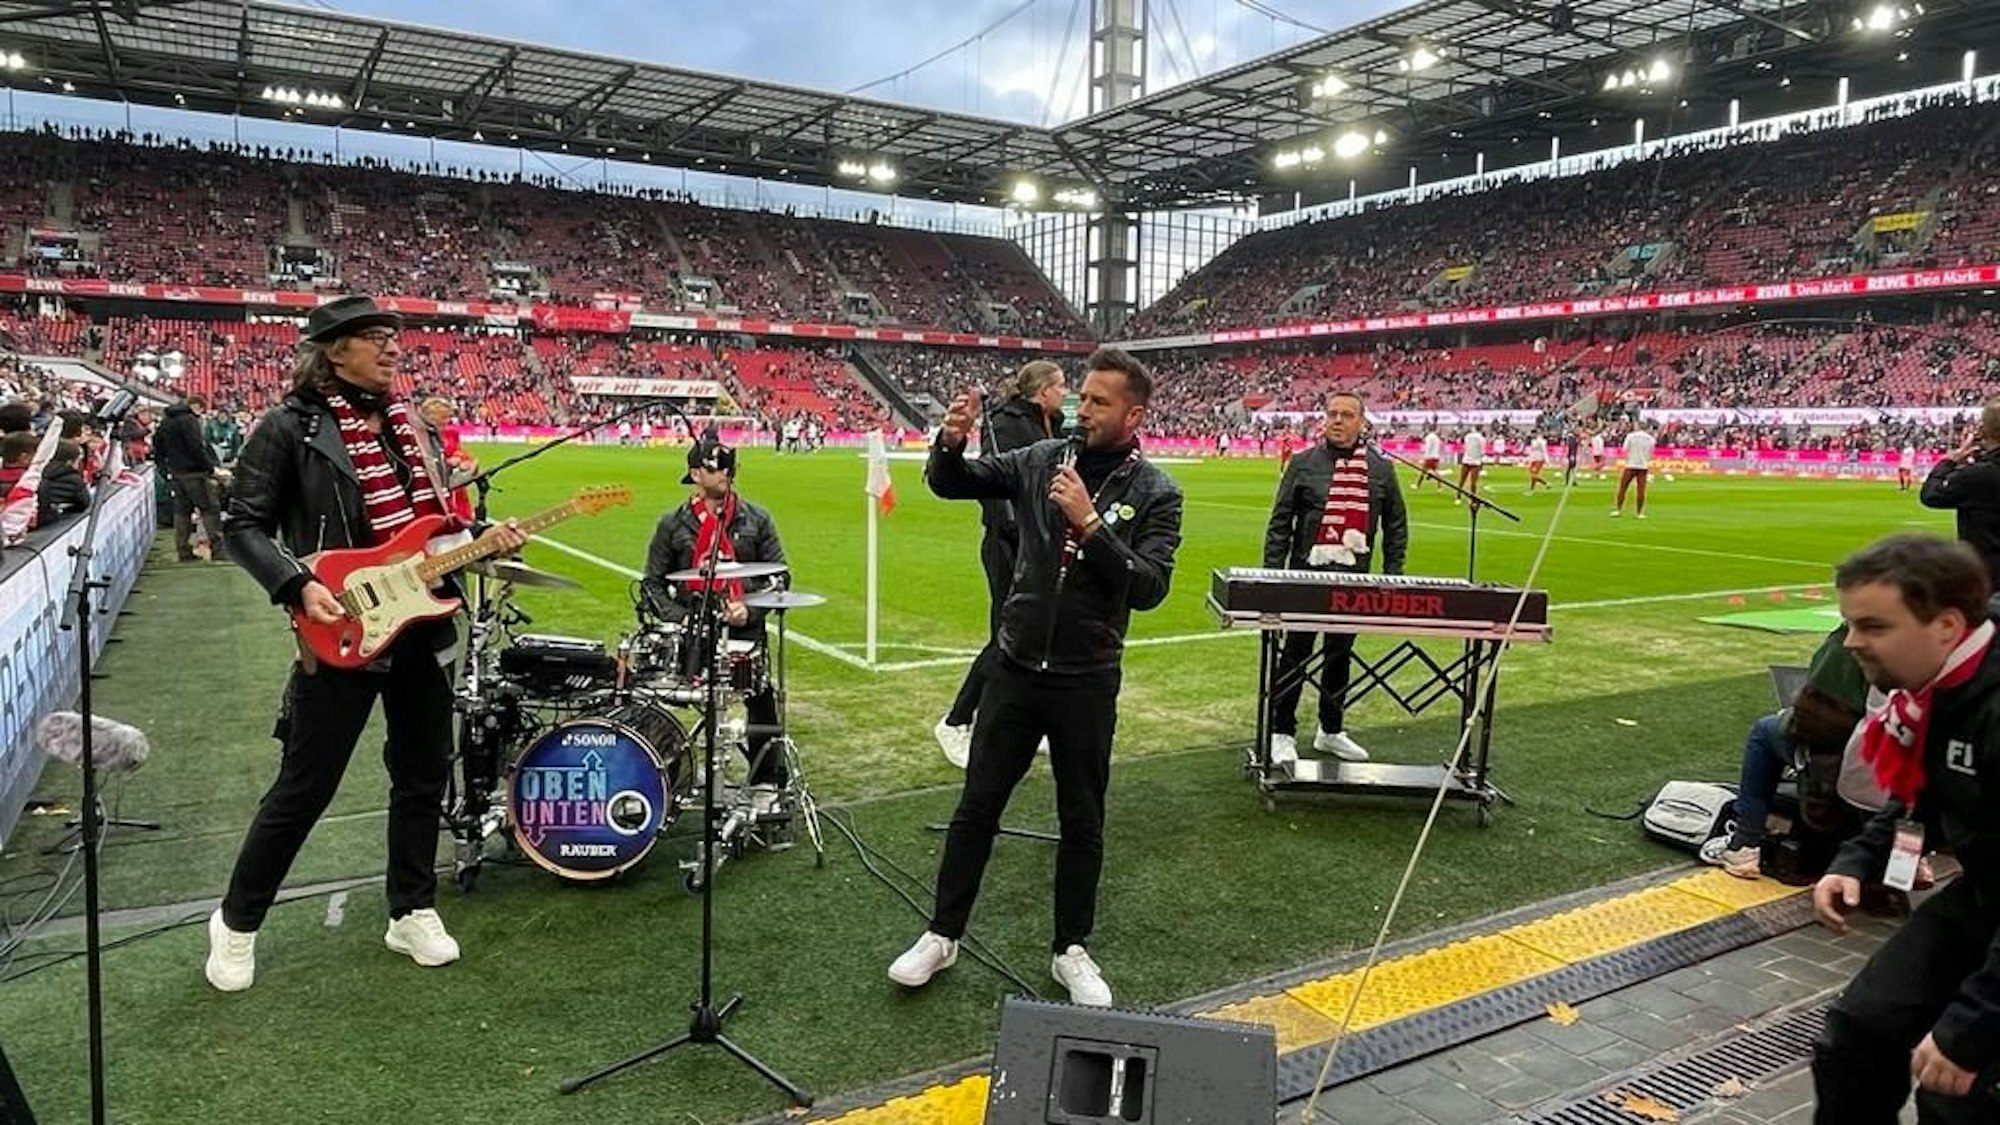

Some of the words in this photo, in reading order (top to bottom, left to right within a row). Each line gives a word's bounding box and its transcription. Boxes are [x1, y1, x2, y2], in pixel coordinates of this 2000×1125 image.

[26, 278, 63, 290] REWE
[1868, 274, 1907, 291] REWE
[1915, 272, 1940, 287] Dein
[1943, 267, 1980, 284] Markt
[109, 284, 147, 297] REWE
[1757, 283, 1791, 299] REWE
[1822, 278, 1853, 294] Markt
[243, 290, 277, 304] REWE
[1659, 292, 1690, 306] REWE
[573, 733, 617, 747] SONOR
[521, 770, 607, 801] OBEN
[522, 801, 606, 825] UNTEN
